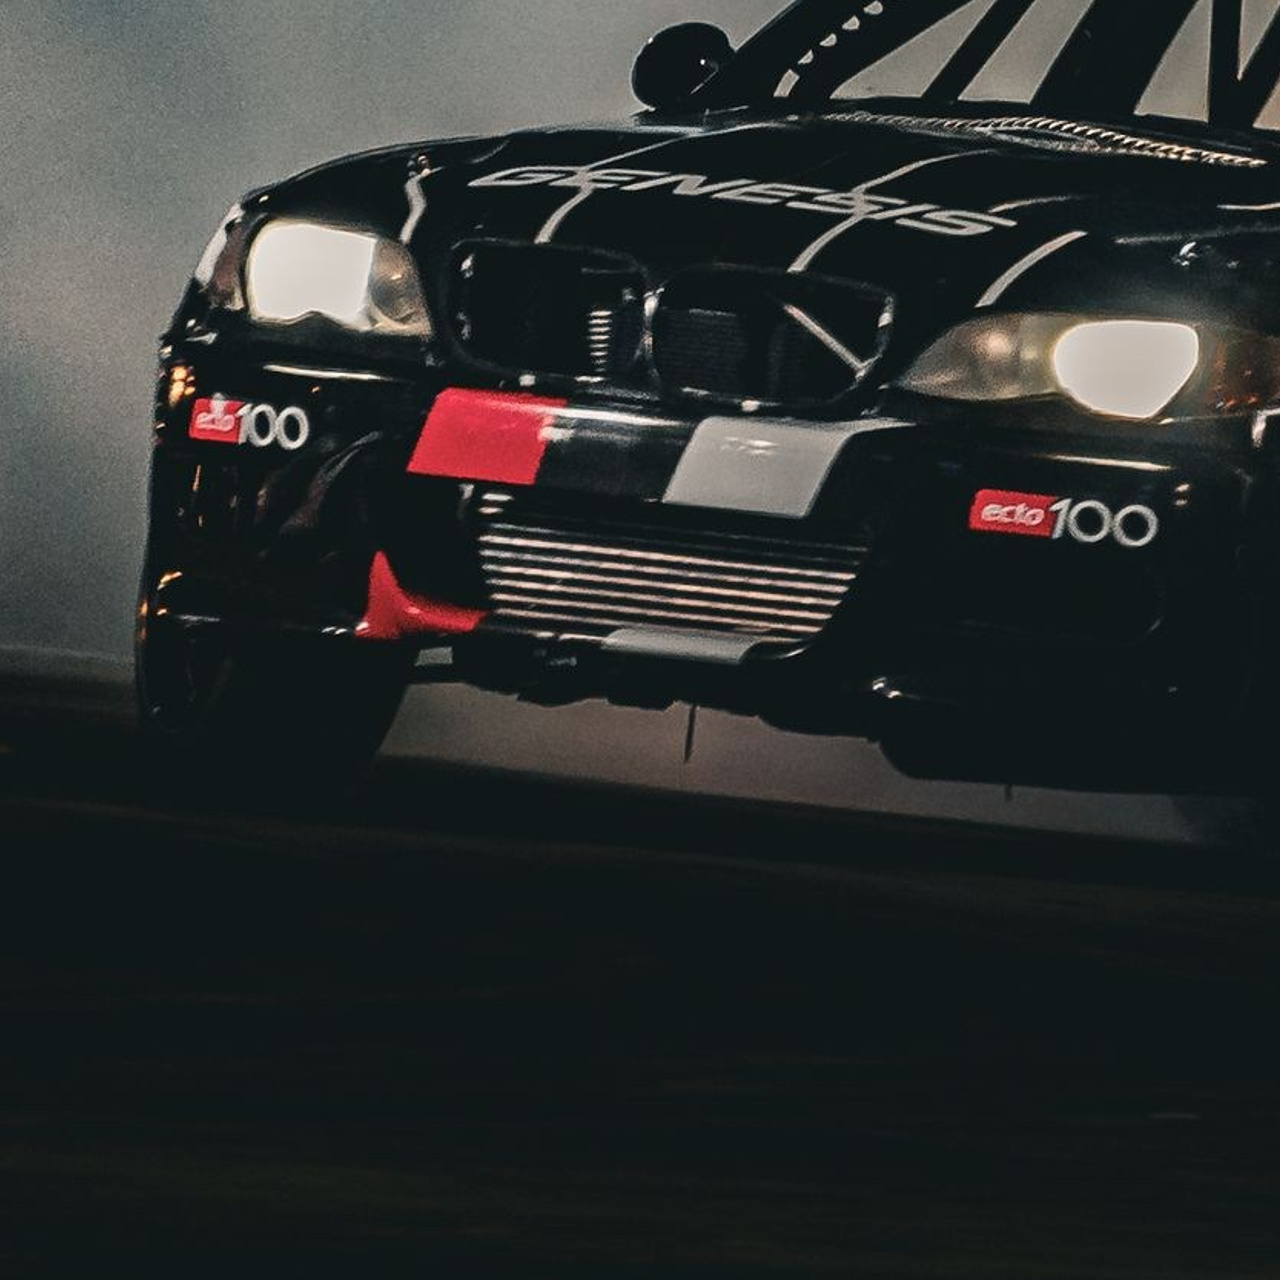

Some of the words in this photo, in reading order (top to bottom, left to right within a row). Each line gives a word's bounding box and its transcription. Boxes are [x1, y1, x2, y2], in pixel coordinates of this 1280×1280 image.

[468, 166, 1018, 237] GENESIS
[235, 403, 309, 450] 100
[1050, 497, 1159, 547] 100
